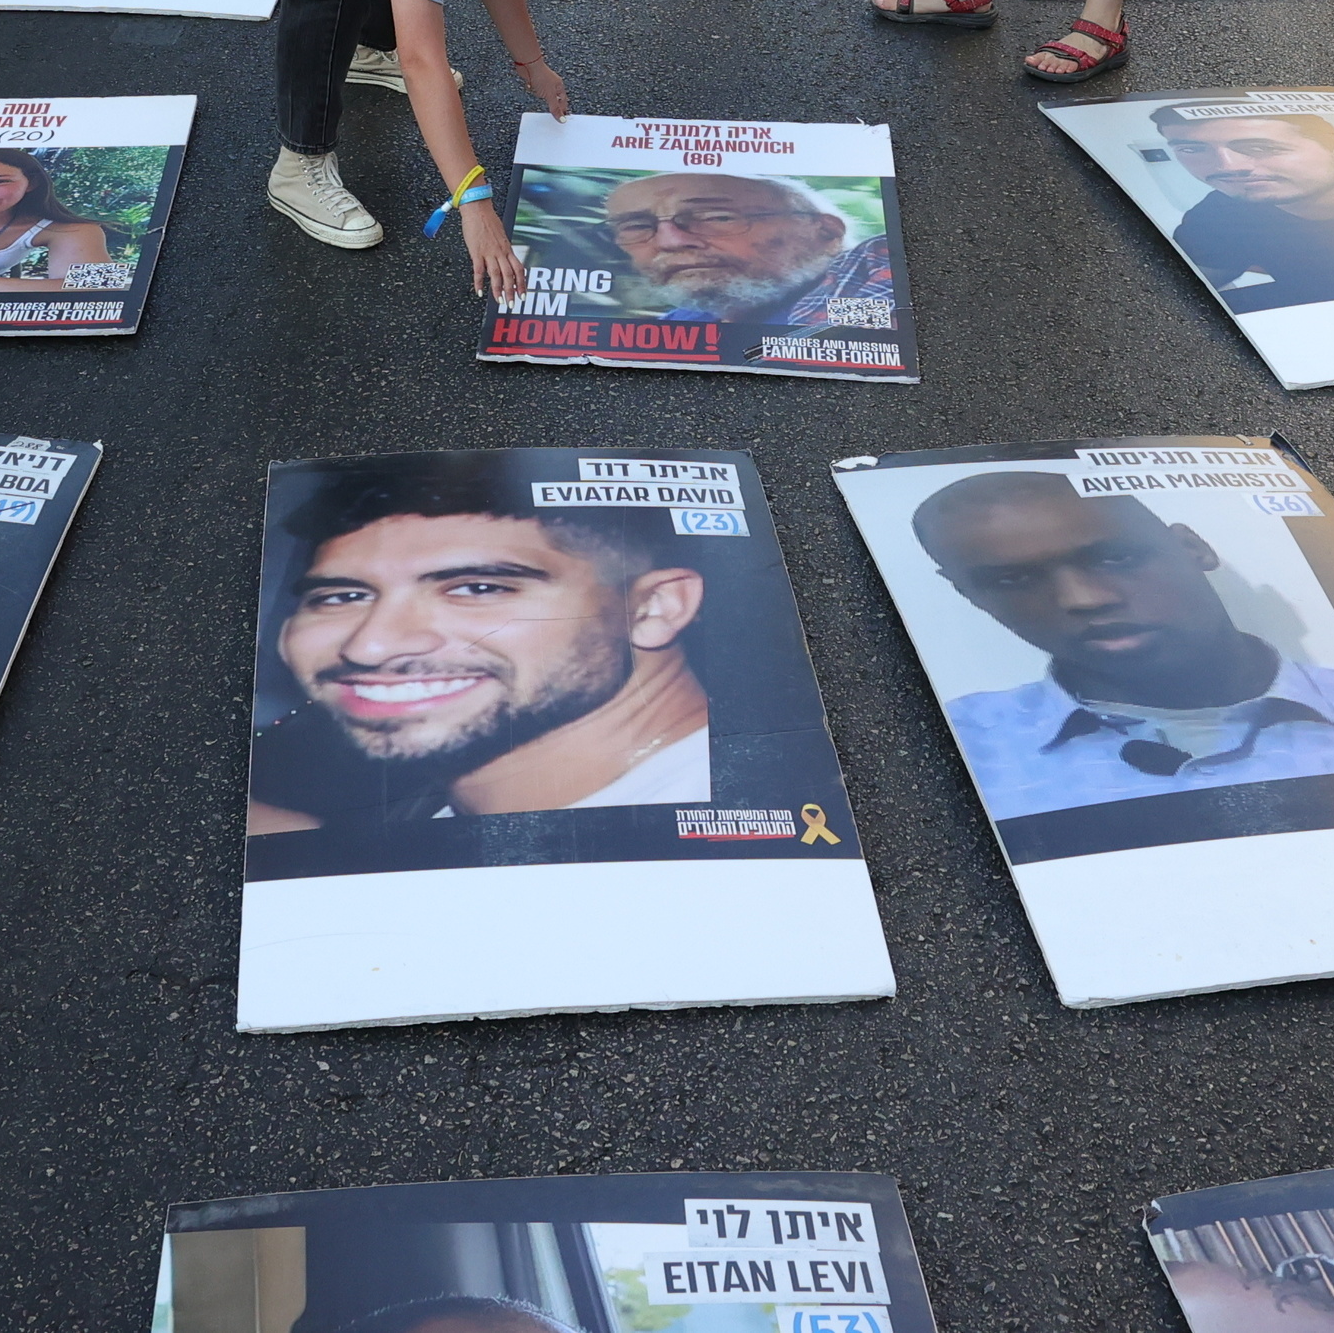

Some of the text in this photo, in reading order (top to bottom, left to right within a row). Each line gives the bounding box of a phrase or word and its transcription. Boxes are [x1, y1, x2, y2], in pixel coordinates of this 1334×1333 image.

[2, 102, 51, 115] נעמה
[1183, 106, 1285, 118] YONATHAN
[19, 115, 68, 128] LEVY
[635, 122, 772, 139] אריה זלמנוביץ'
[611, 136, 795, 154] ARIE ZALMANOVICH
[683, 152, 723, 167] (86)
[492, 319, 720, 352] HOME NOW!
[762, 336, 899, 354] HOSTAGES AND MISSING
[762, 344, 901, 367] FAMILIES FORUM
[1086, 449, 1277, 467] אברה מנגיסטו
[586, 462, 729, 481] אביתר דוד
[1082, 471, 1297, 493] AVERA MANGISTO
[541, 486, 735, 505] EVIATAR DAVID
[1252, 494, 1316, 516] (36)
[681, 511, 740, 535] (23)
[675, 809, 794, 821] מטה המשפחות להחזרת
[677, 820, 796, 836] החטופים והנעדרים
[696, 1205, 865, 1245] איתן לוי
[663, 1260, 875, 1294] EITAN LEVI
